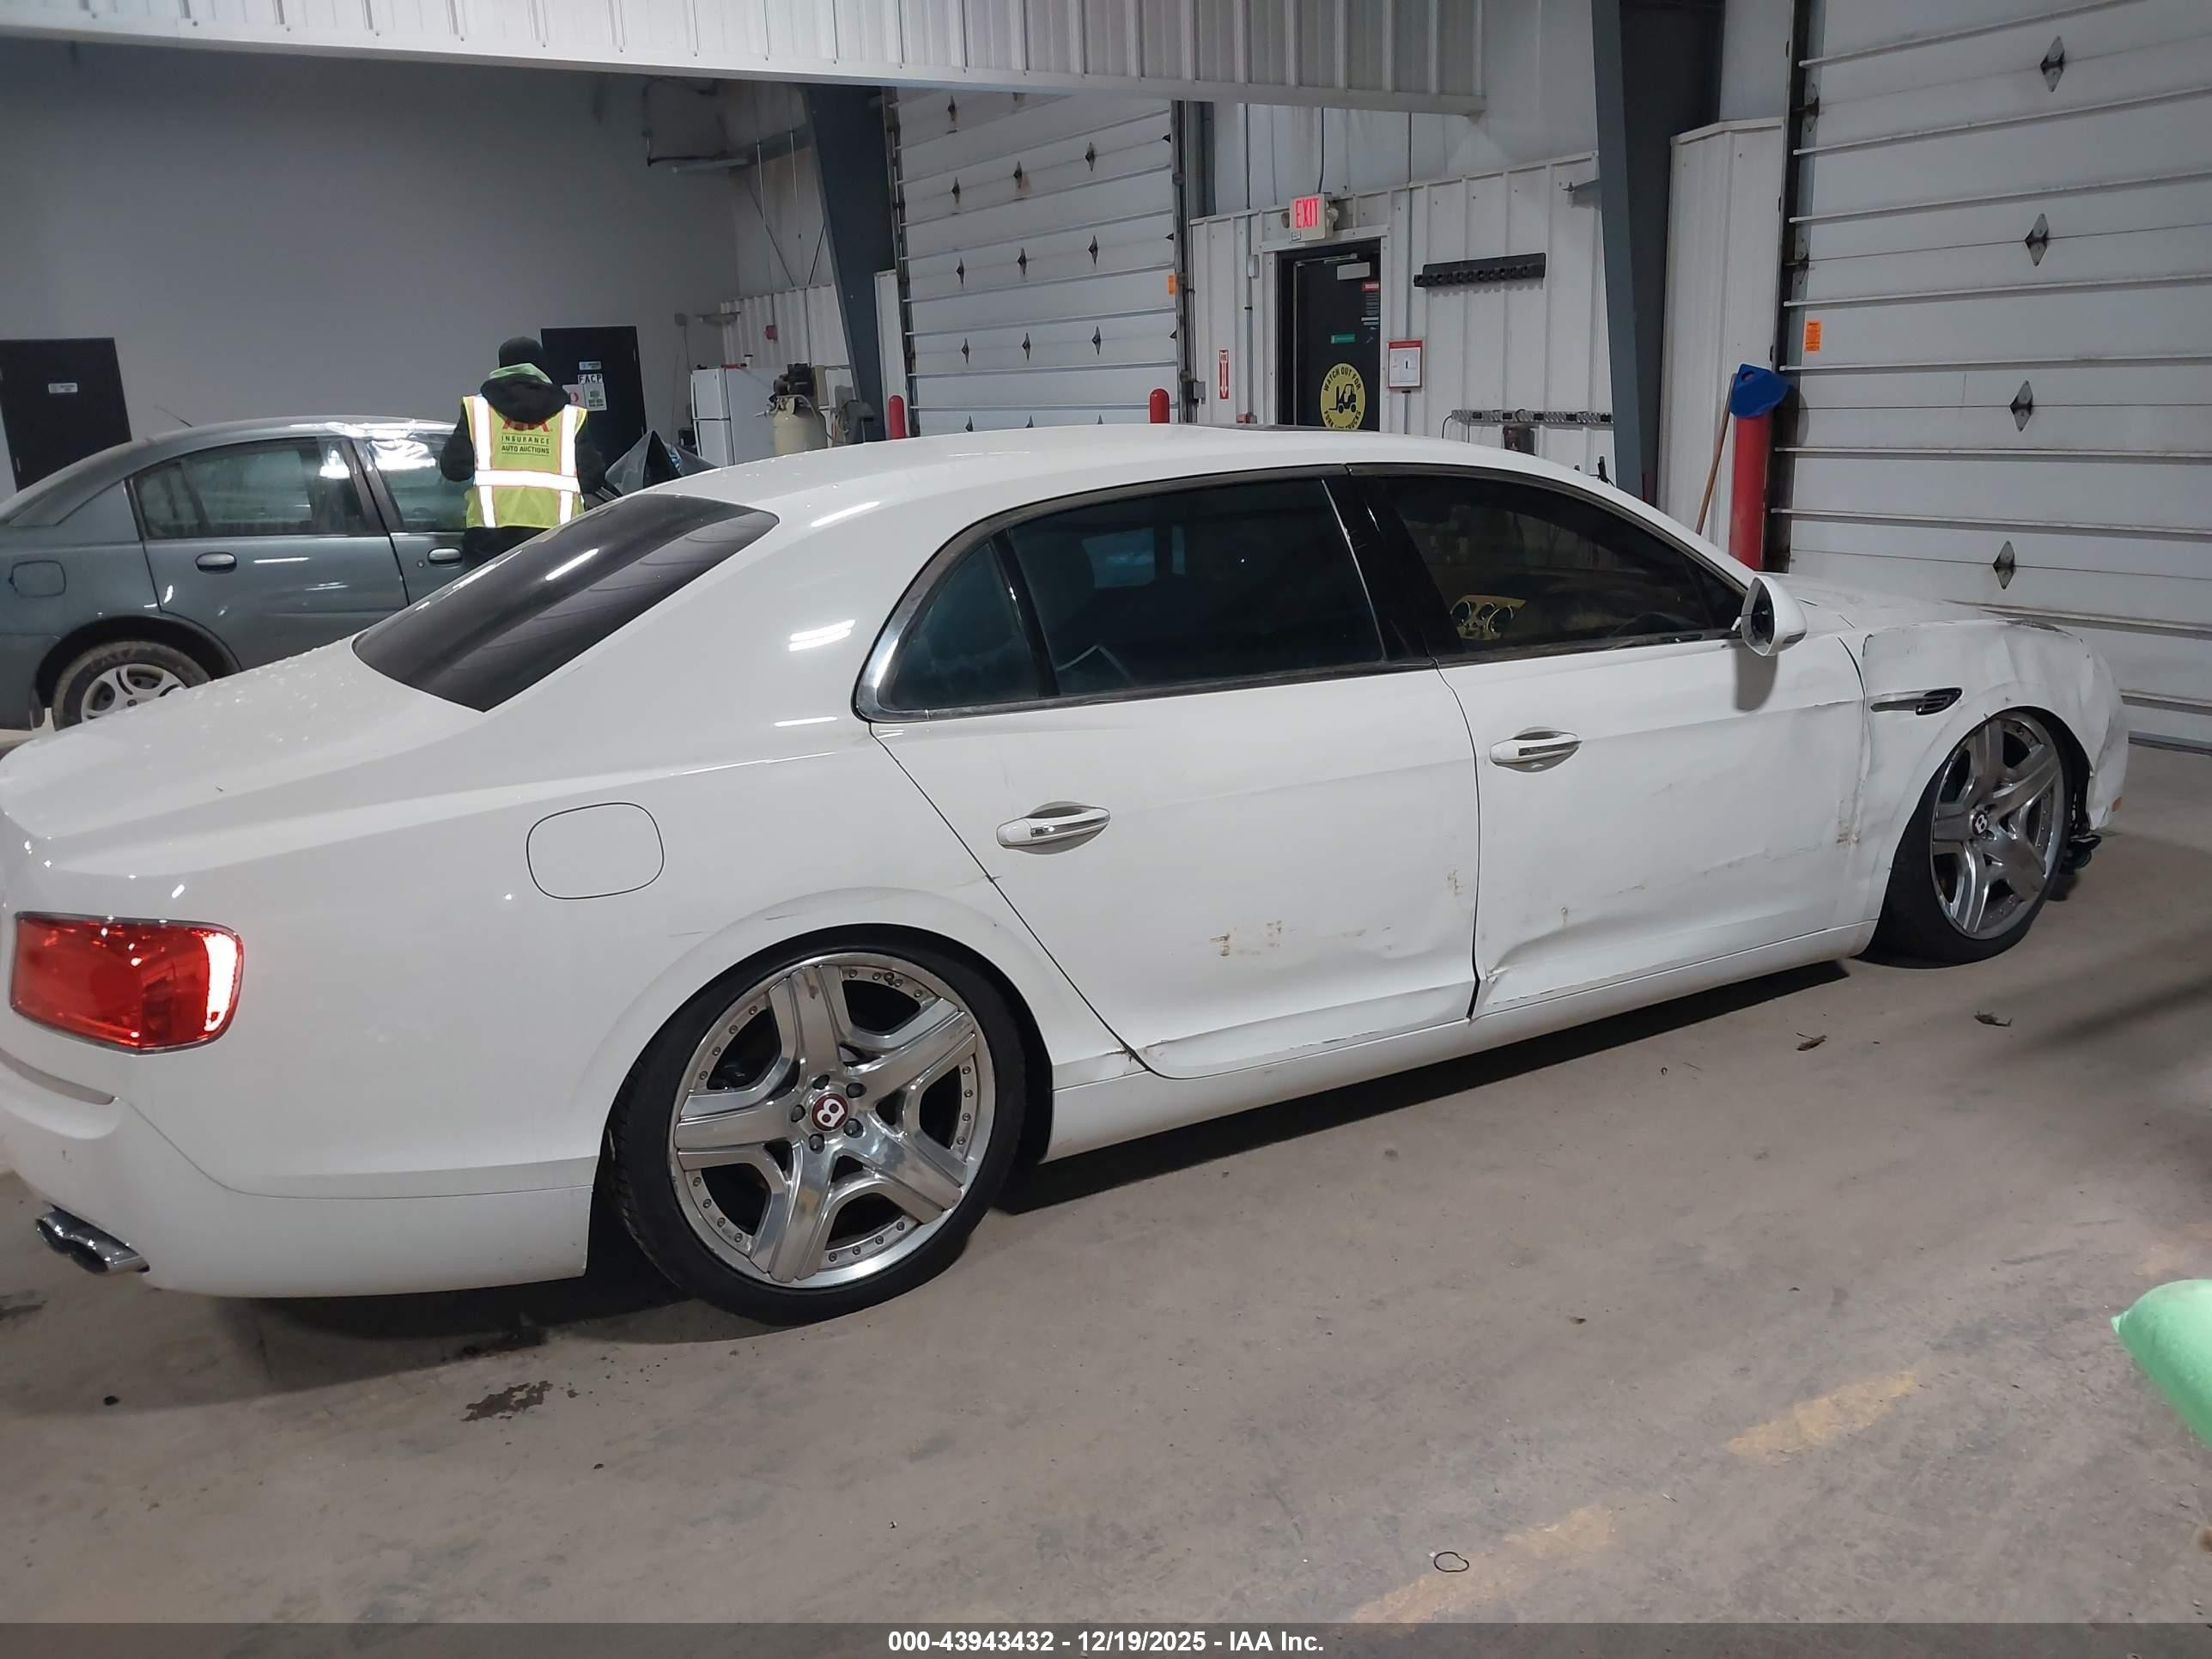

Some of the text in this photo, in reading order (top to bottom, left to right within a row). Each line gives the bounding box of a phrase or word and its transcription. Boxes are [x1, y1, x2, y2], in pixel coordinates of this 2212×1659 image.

[1295, 198, 1319, 228] EXIT
[579, 374, 602, 385] FACP
[1323, 367, 1362, 392] WATCH OUT FOR
[501, 435, 550, 445] INSURANCE
[520, 446, 550, 454] AUCTIONS
